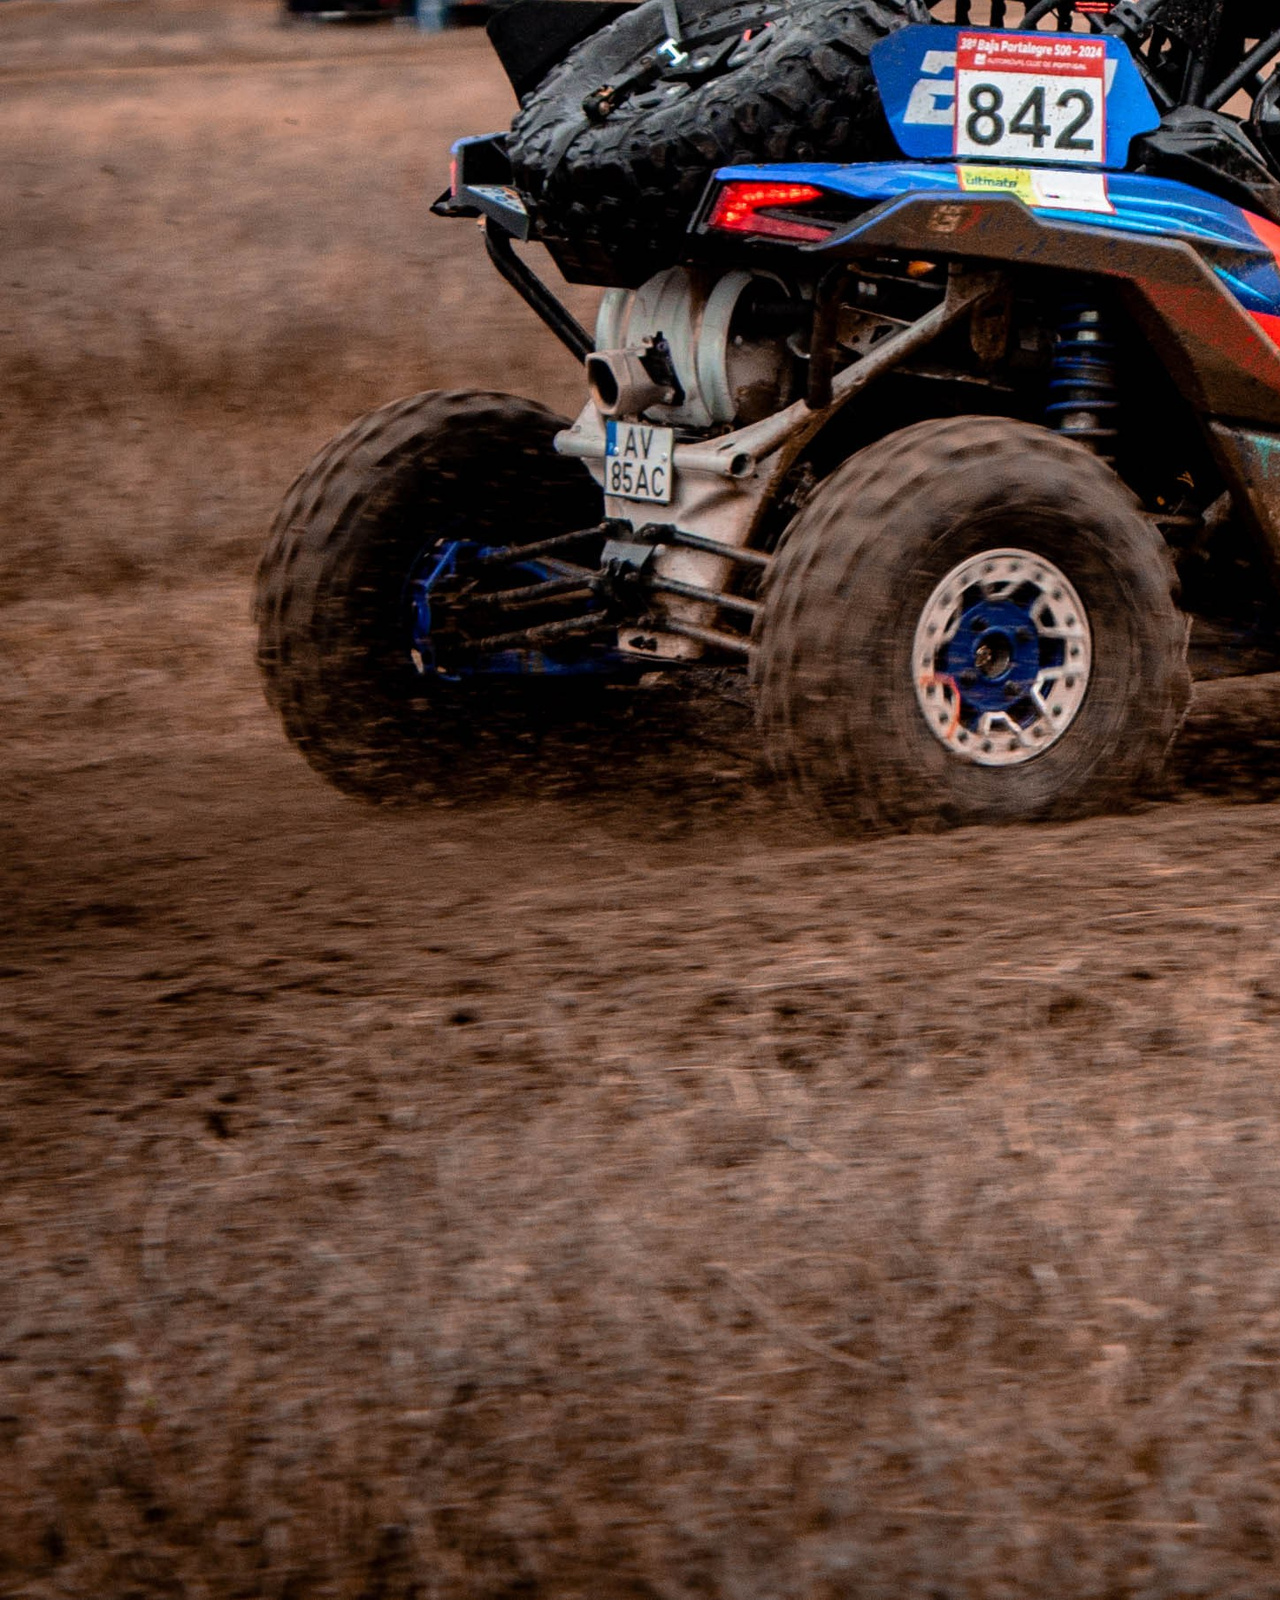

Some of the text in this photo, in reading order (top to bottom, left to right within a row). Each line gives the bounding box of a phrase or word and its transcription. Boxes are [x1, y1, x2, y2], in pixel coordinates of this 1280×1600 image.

[977, 39, 999, 54] Baja
[1000, 40, 1053, 57] Portalegre
[1078, 45, 1102, 58] 2024
[965, 82, 1095, 151] 842
[966, 176, 1018, 189] ultimate
[623, 426, 654, 459] AV
[611, 461, 665, 497] 85AC
